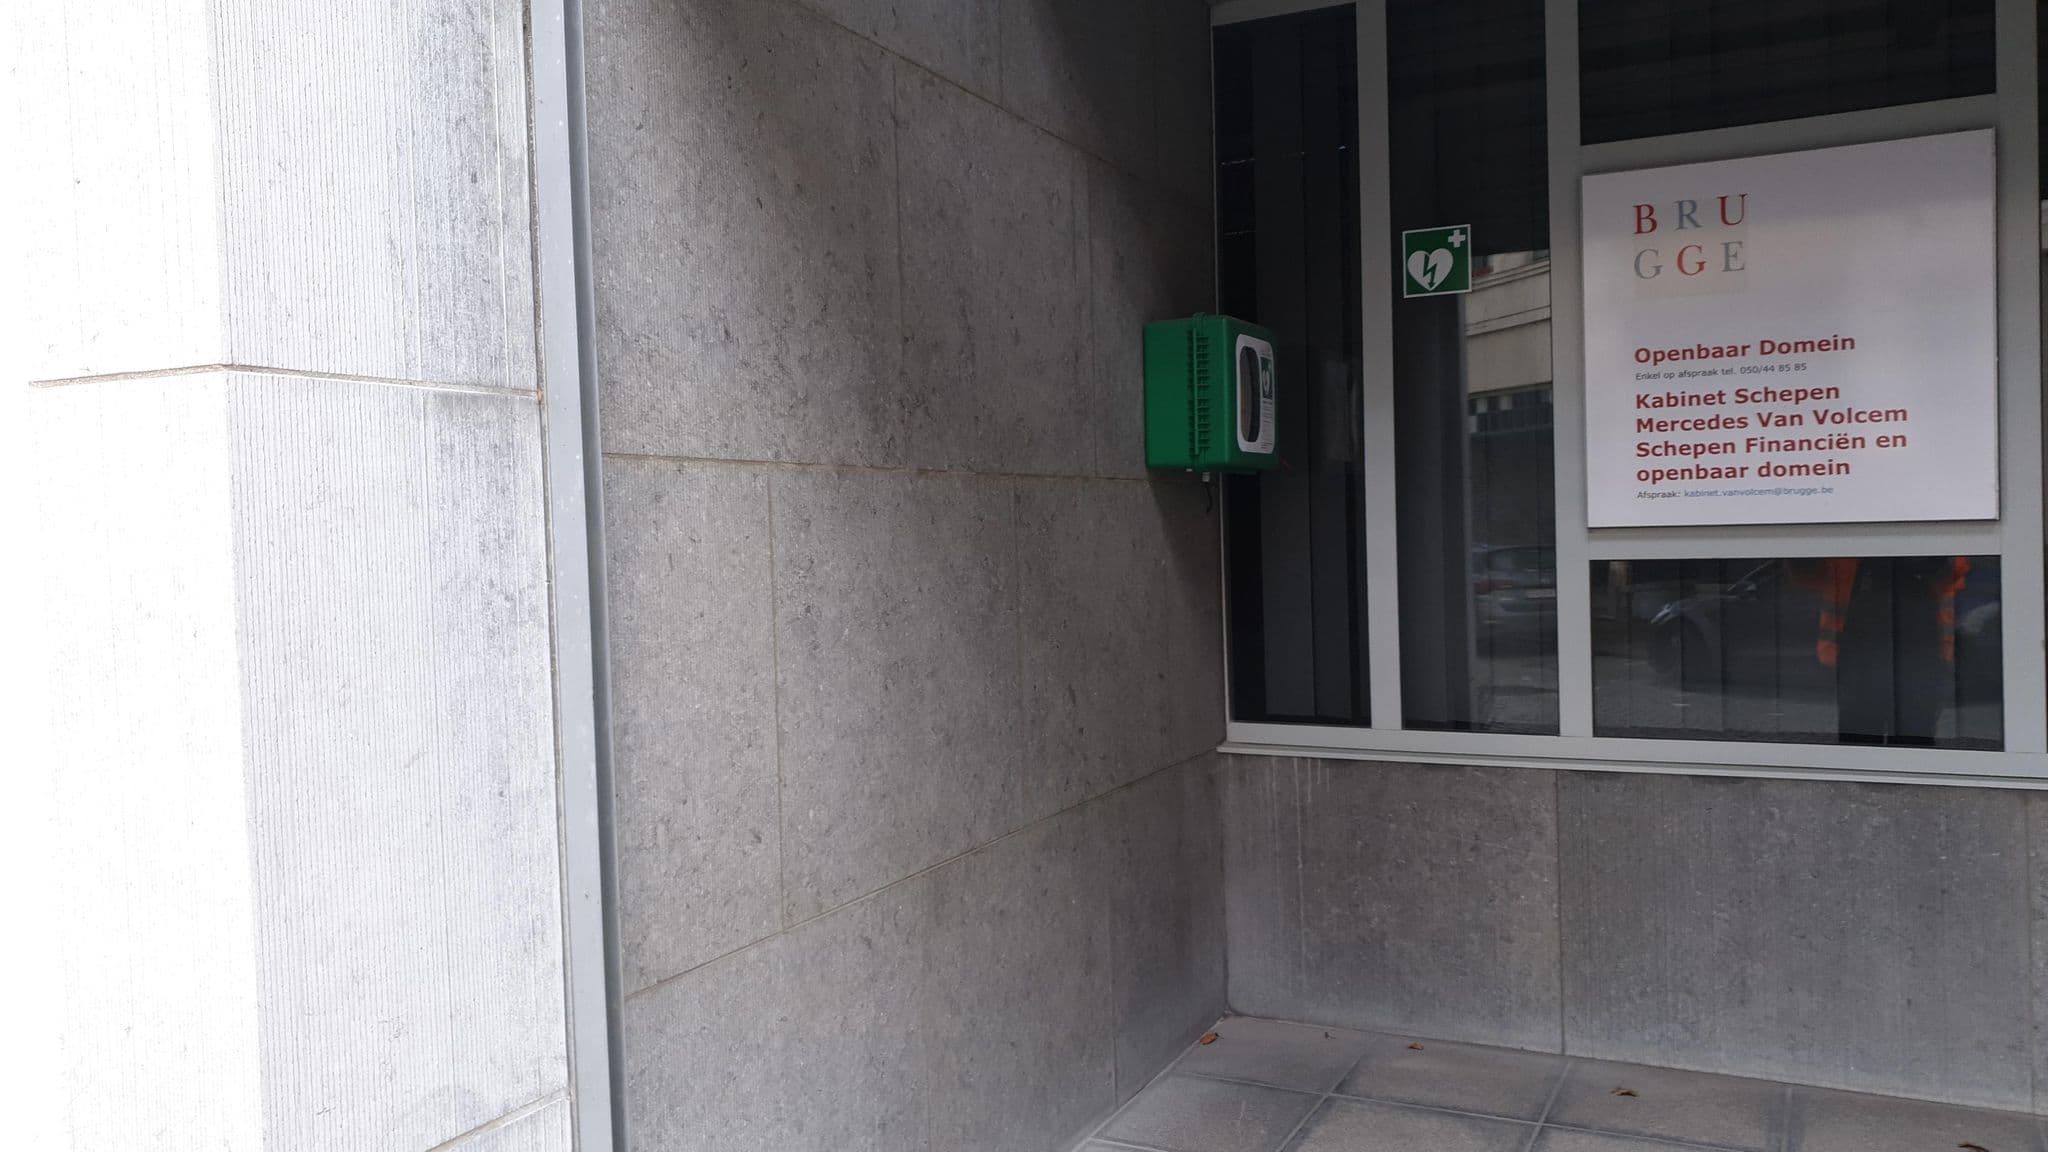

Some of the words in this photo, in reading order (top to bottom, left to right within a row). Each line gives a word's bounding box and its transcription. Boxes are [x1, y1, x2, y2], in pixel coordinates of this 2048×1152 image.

[1634, 343, 1751, 365] Openbaar
[1759, 335, 1856, 355] Domein
[1635, 371, 1661, 381] Enkel
[1663, 371, 1675, 381] op
[1678, 367, 1718, 380] afspraak
[1721, 367, 1737, 376] tel.
[1636, 391, 1726, 409] Kabinet
[1735, 385, 1840, 407] Schepen
[1637, 413, 1749, 433] Mercedes
[1757, 410, 1804, 428] Van
[1812, 407, 1909, 426] Volcem
[1636, 438, 1736, 460] Schepen
[1745, 434, 1866, 454] Financiën
[1876, 434, 1908, 448] en
[1637, 462, 1748, 484] openbaar
[1757, 460, 1850, 477] domein
